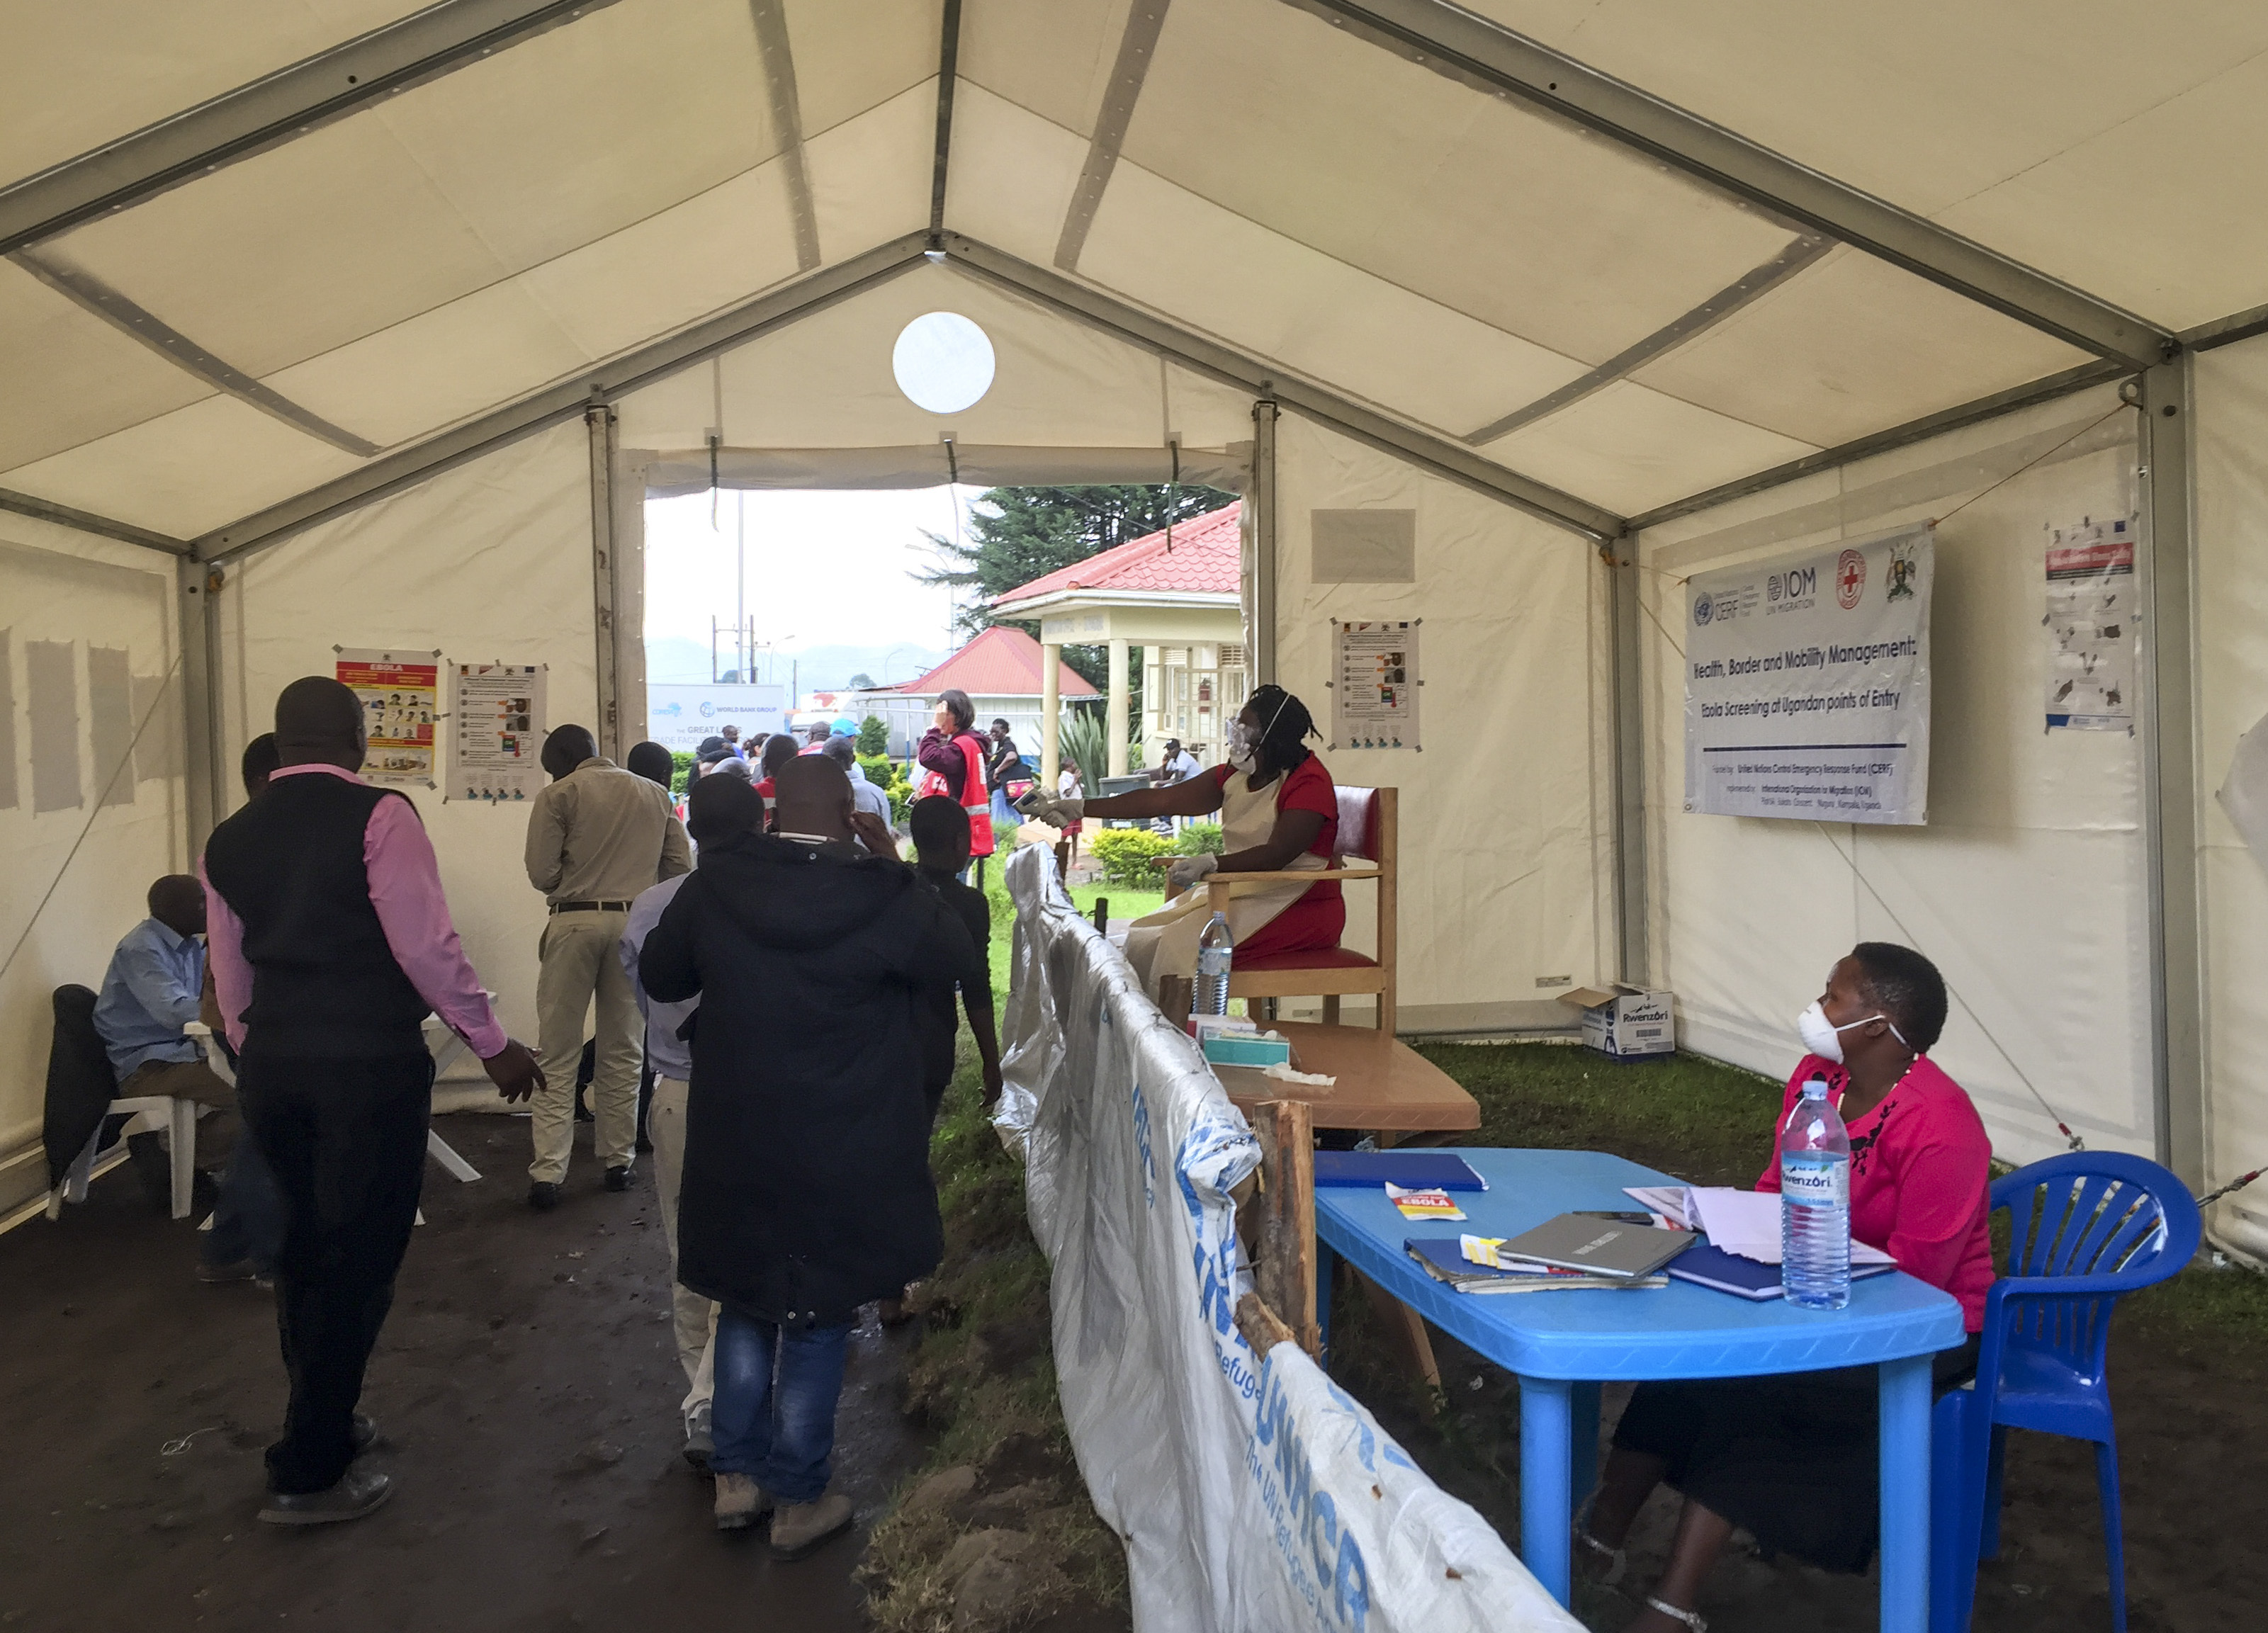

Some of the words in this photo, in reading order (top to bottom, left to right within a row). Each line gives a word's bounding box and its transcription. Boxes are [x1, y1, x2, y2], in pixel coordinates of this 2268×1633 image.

[1783, 567, 1817, 600] IOM
[370, 663, 404, 672] EBOLA
[1693, 660, 1726, 679] Health,
[1729, 655, 1761, 676] Border
[1764, 651, 1783, 672] and
[1785, 647, 1826, 669] Mobility
[1828, 635, 1917, 665] Management:
[1701, 702, 1723, 718] Ebola
[1725, 699, 1770, 718] Screening
[1771, 696, 1781, 713] at
[1783, 694, 1826, 716] Ugandan
[1826, 691, 1856, 714] points
[1859, 689, 1871, 707] of
[1871, 689, 1901, 711] Entry
[1246, 1435, 1262, 1484] The
[1263, 1471, 1280, 1519] UN
[1256, 1353, 1369, 1633] UNHCR
